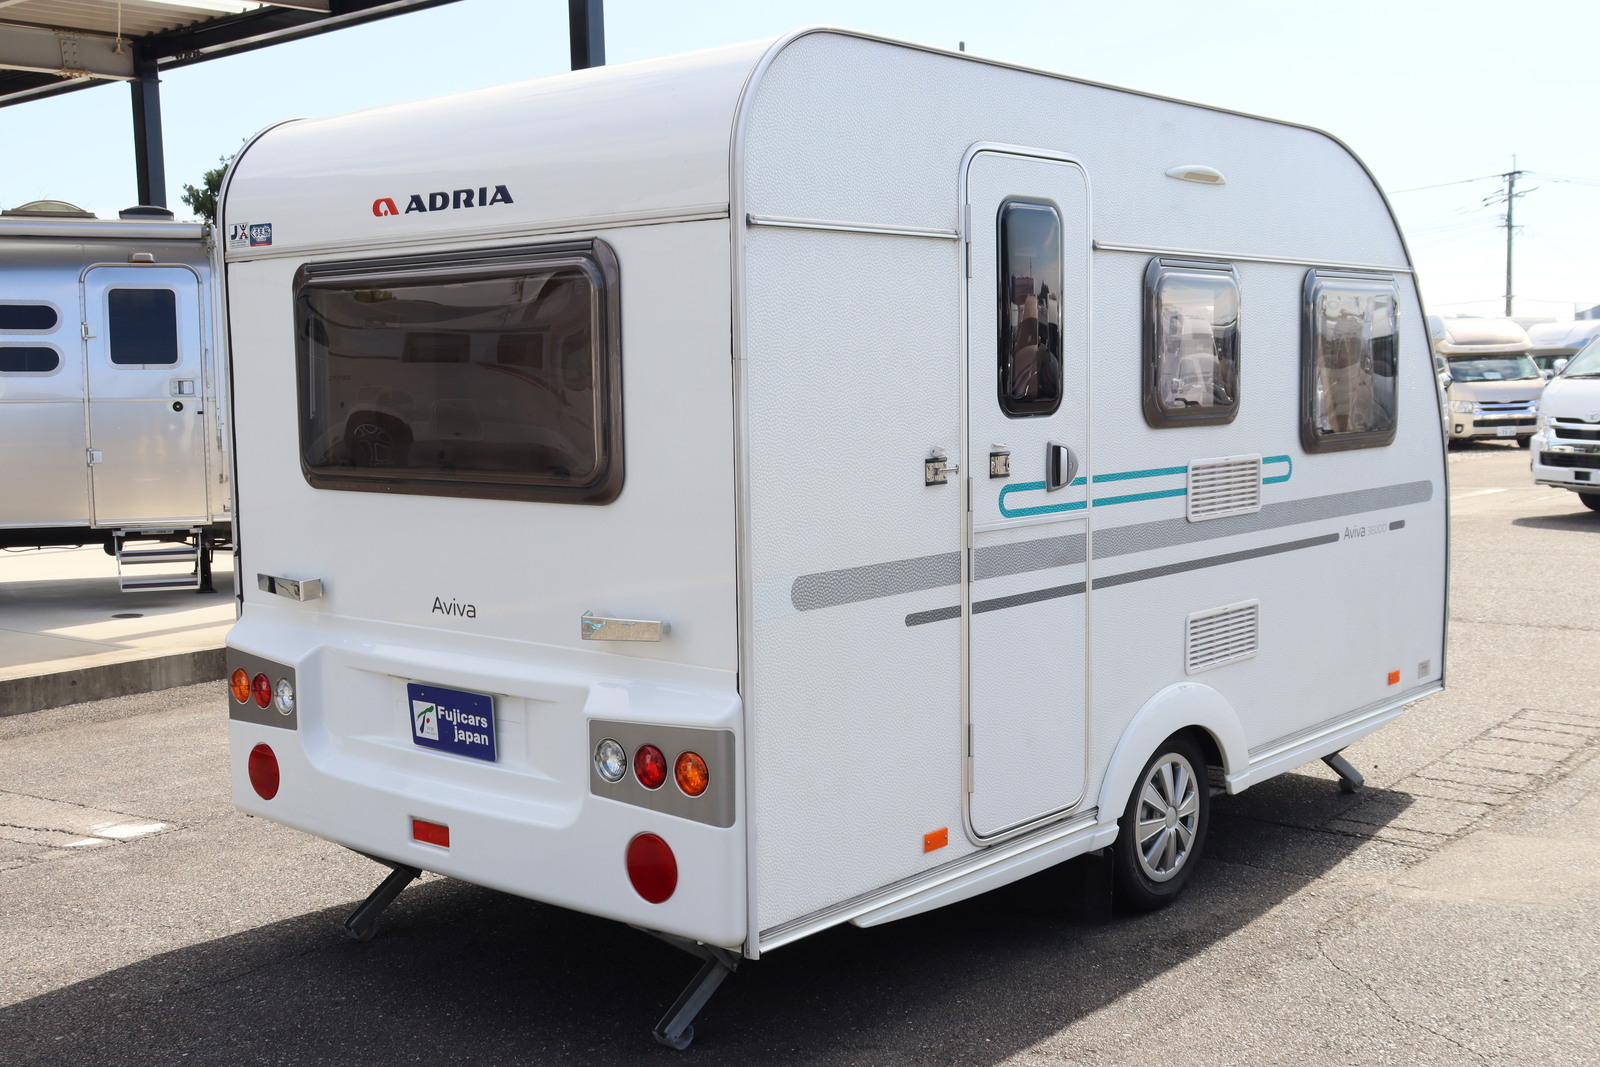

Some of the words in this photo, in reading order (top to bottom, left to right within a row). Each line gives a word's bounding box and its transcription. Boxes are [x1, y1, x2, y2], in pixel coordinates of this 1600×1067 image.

[404, 184, 514, 215] ADRIA
[1343, 524, 1366, 541] Aviva
[431, 596, 477, 619] Aviva
[437, 705, 488, 729] Fujicars
[453, 726, 489, 746] japan
